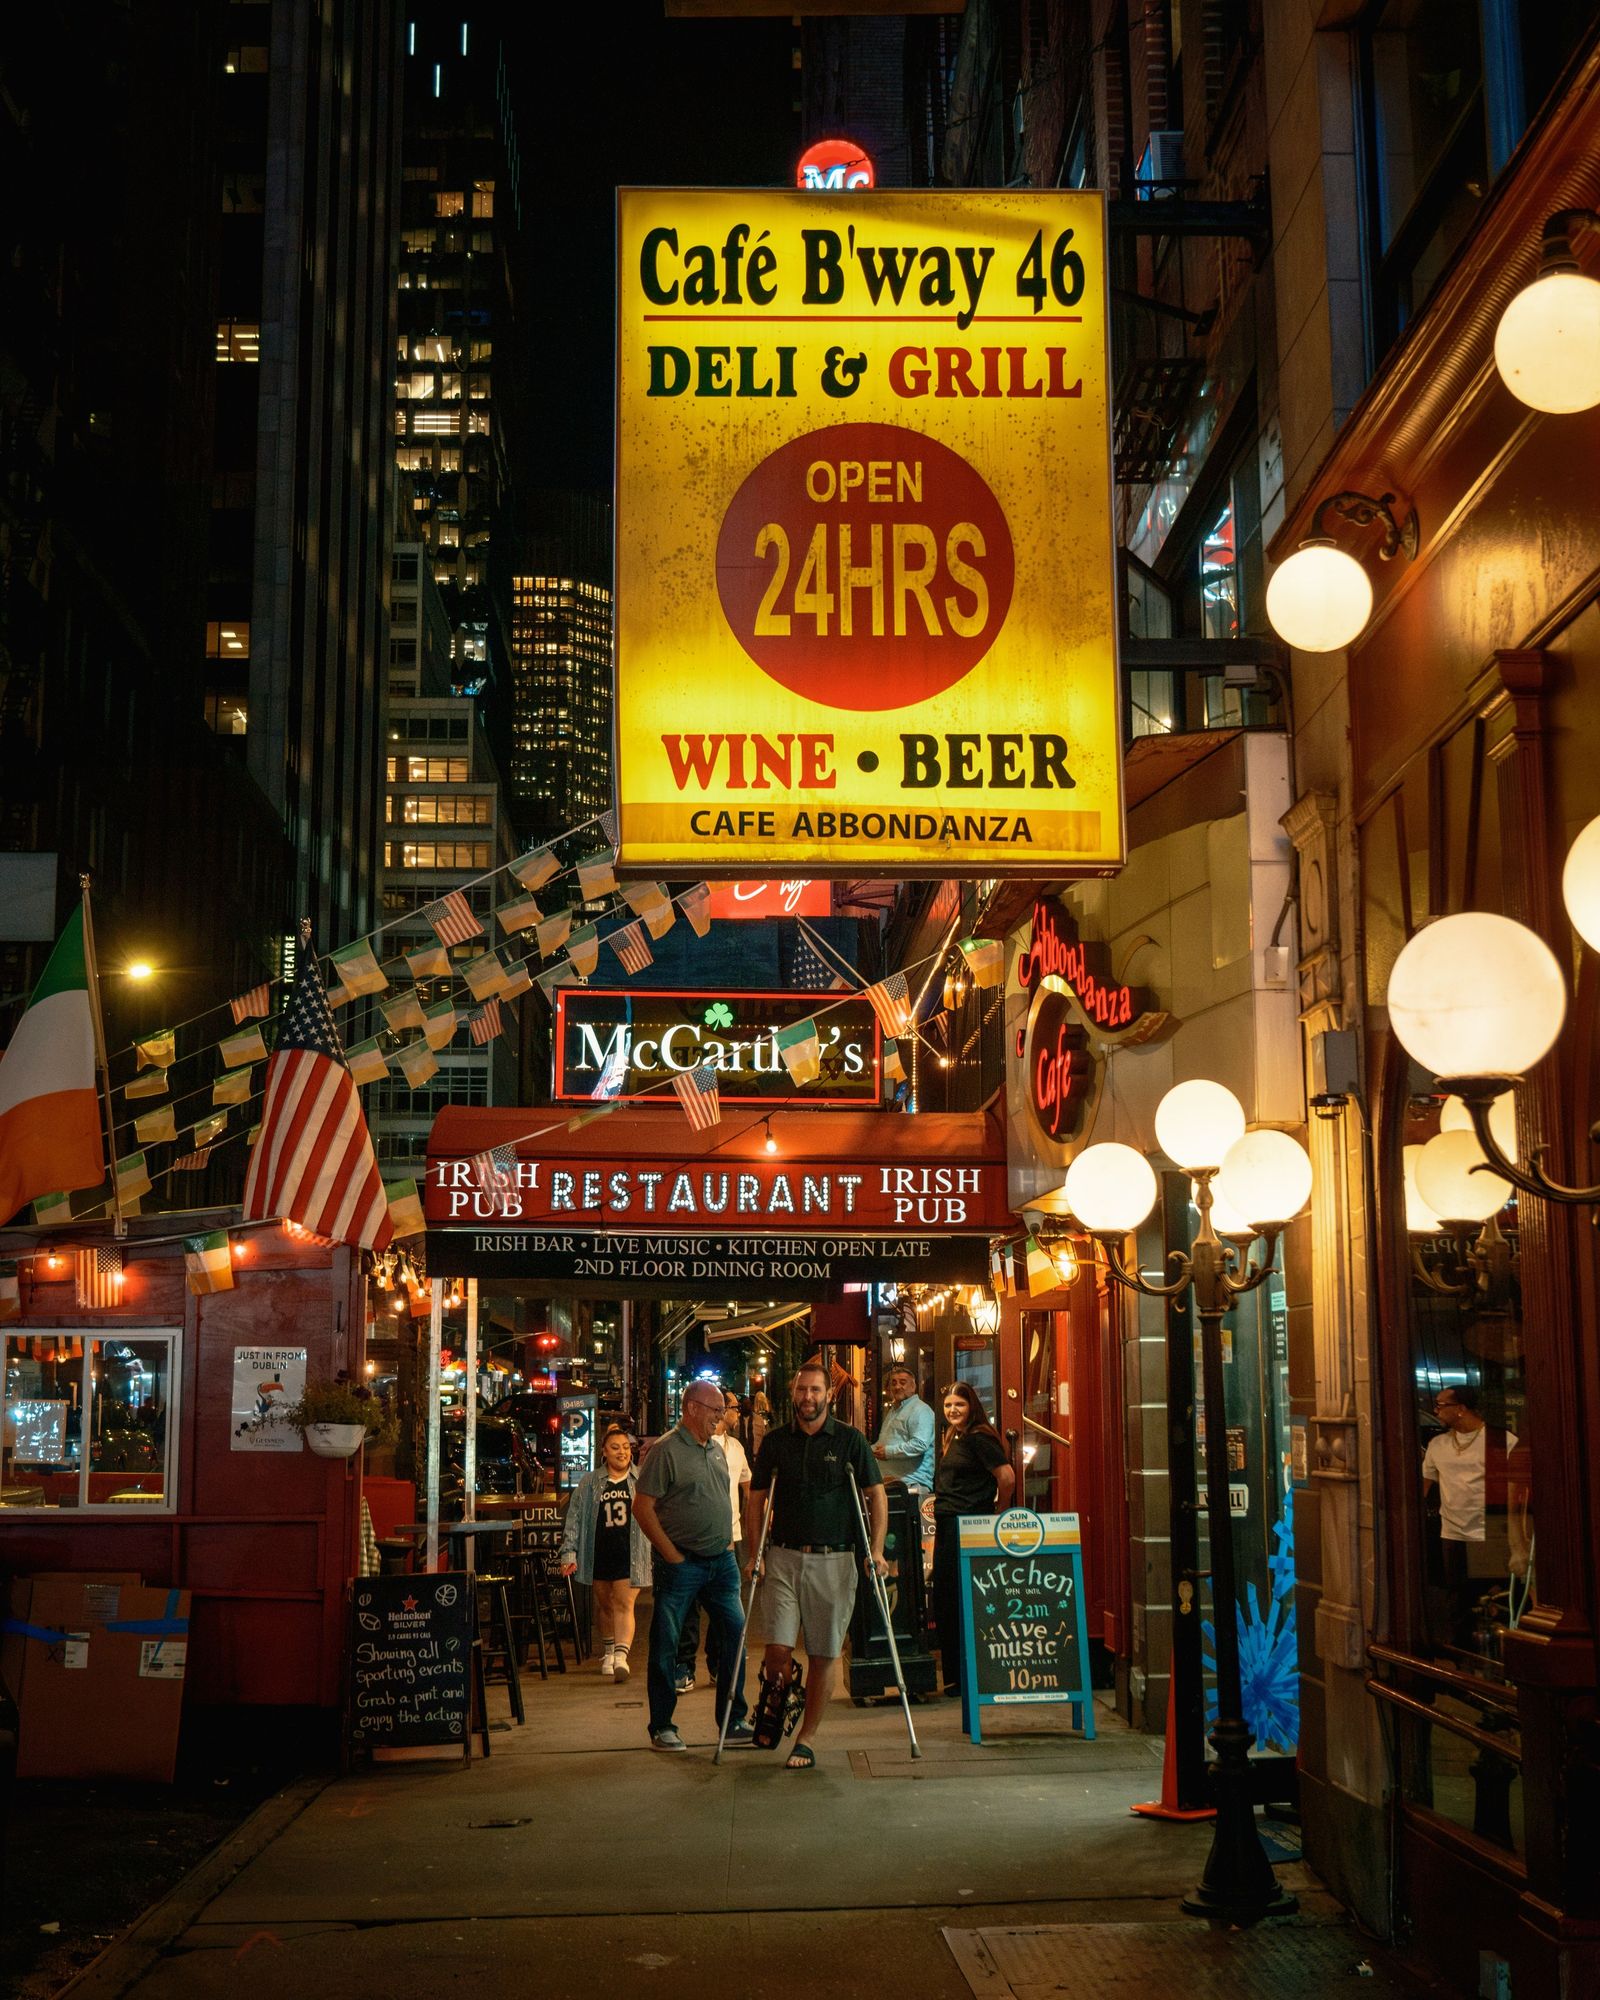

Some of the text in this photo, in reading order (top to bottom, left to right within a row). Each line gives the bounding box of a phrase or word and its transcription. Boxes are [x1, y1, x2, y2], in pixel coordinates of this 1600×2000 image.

[640, 223, 1086, 330] Café B'way 46
[646, 345, 1083, 399] DELI & GRILL
[805, 461, 922, 503] OPEN
[753, 522, 989, 638] 24HRS
[661, 733, 1076, 790] WINE BEER
[690, 810, 775, 837] CAFE
[793, 811, 1033, 842] ABBONDANZA
[1018, 901, 1132, 1027] Abbondanza
[1037, 1023, 1072, 1135] Cafe
[436, 1162, 540, 1188] IRISH
[880, 1167, 983, 1195] IRISH
[448, 1191, 523, 1217] PUB
[550, 1171, 863, 1214] RESTAURANT
[894, 1197, 968, 1224] PUB
[473, 1236, 931, 1257] IRISH BAR LIVE MUSIC KITCHEN OPEN LATE
[574, 1259, 831, 1279] 2ND FLOOR DINING ROOM
[238, 1352, 302, 1360] JUST IN FROM
[252, 1362, 288, 1370] DUBLIN
[604, 1501, 627, 1527] 13
[1001, 1521, 1038, 1529] CRUISER
[1009, 1513, 1028, 1521] SUN
[973, 1560, 1073, 1597] kitchen
[1005, 1588, 1020, 1596] OPEN
[1007, 1598, 1049, 1619] 2am
[393, 1620, 426, 1629] SILVER
[997, 1621, 1048, 1640] live
[357, 1641, 440, 1668] Showing all
[988, 1640, 1057, 1660] music
[419, 1658, 464, 1676] events
[1008, 1668, 1059, 1690] 10pm
[357, 1683, 465, 1711] Grab a pint and
[360, 1707, 464, 1732] enjoy the action
